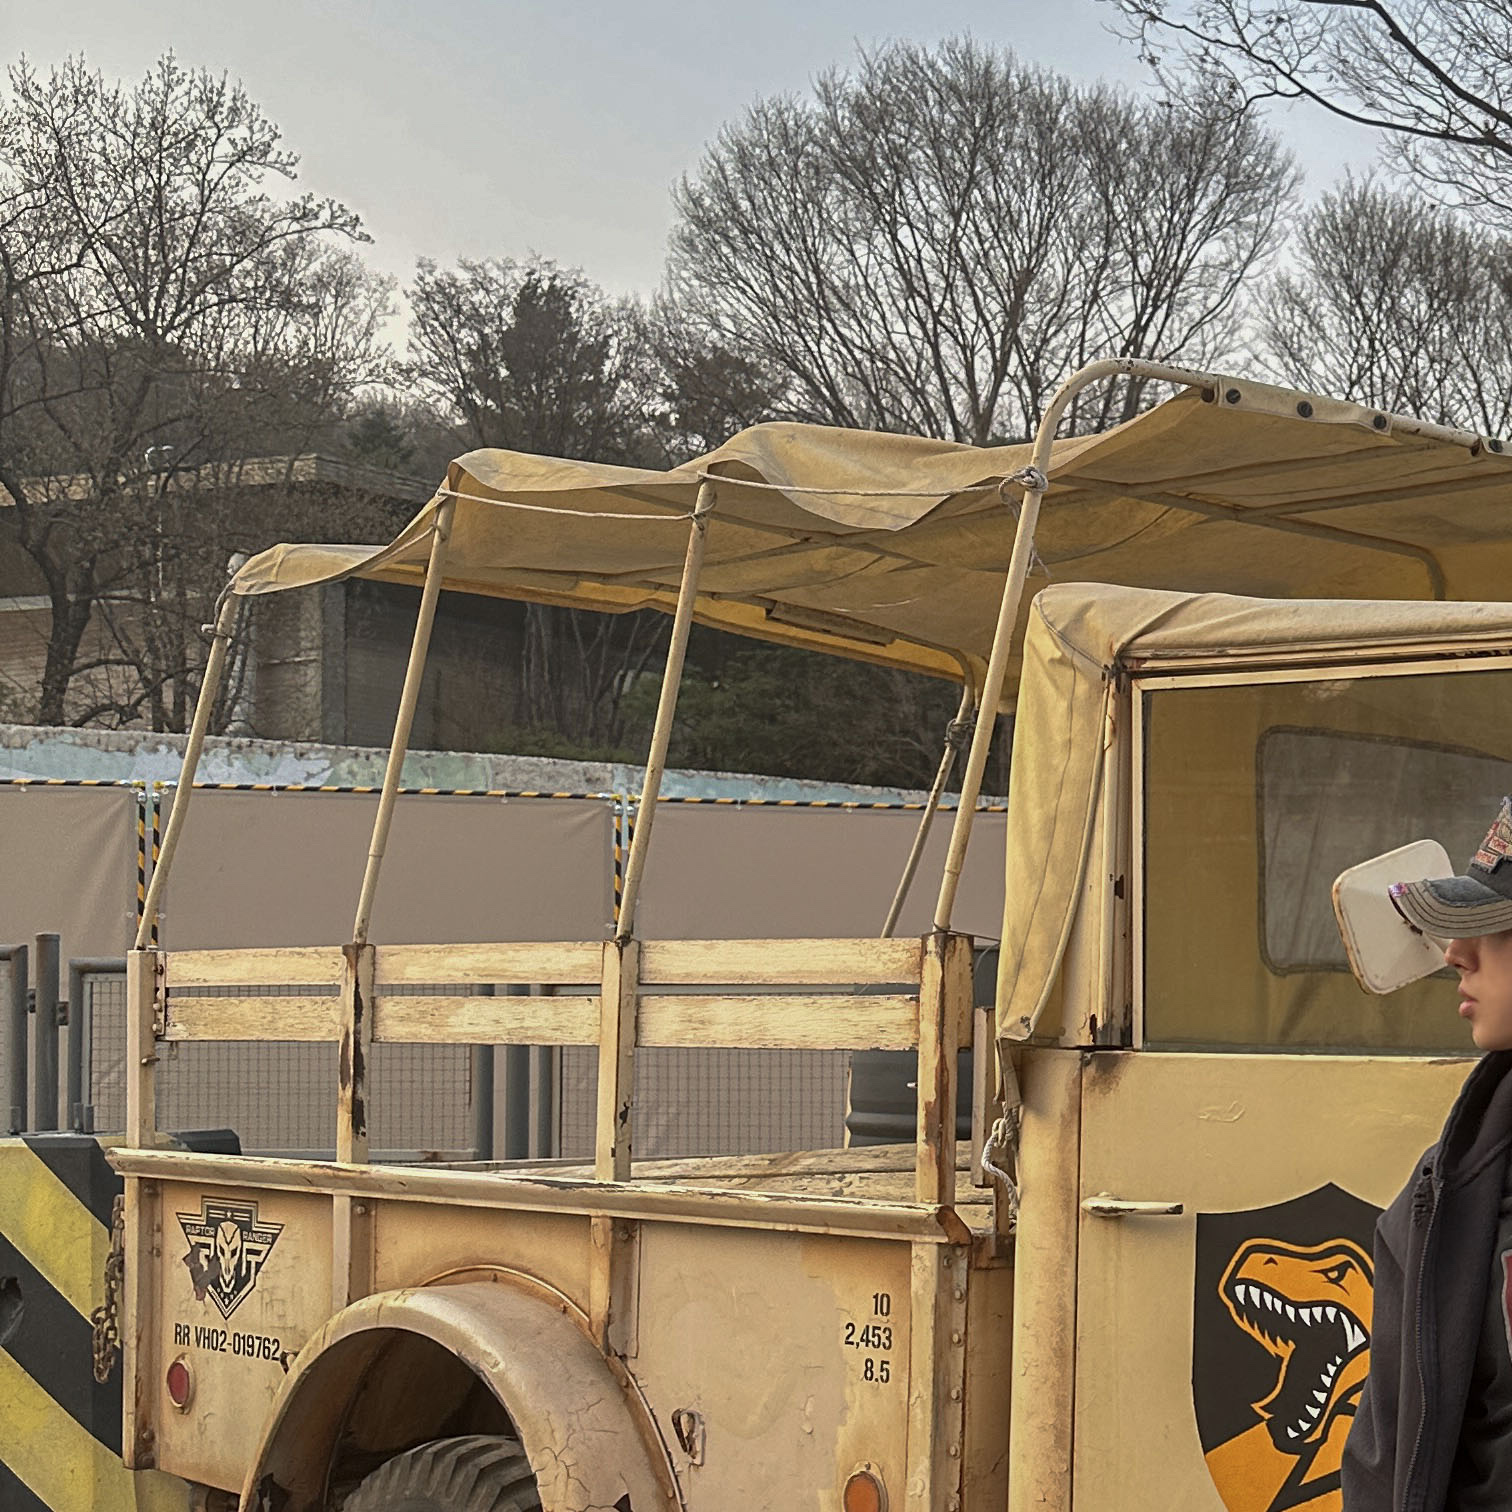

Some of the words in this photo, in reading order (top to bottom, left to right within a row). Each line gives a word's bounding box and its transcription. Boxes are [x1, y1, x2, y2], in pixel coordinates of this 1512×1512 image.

[185, 1224, 216, 1237] RAPTOR
[242, 1230, 273, 1244] RANGER
[872, 1292, 891, 1317] 10
[174, 1322, 190, 1347] RR
[844, 1322, 893, 1351] 2,453
[863, 1357, 891, 1384] 8.5
